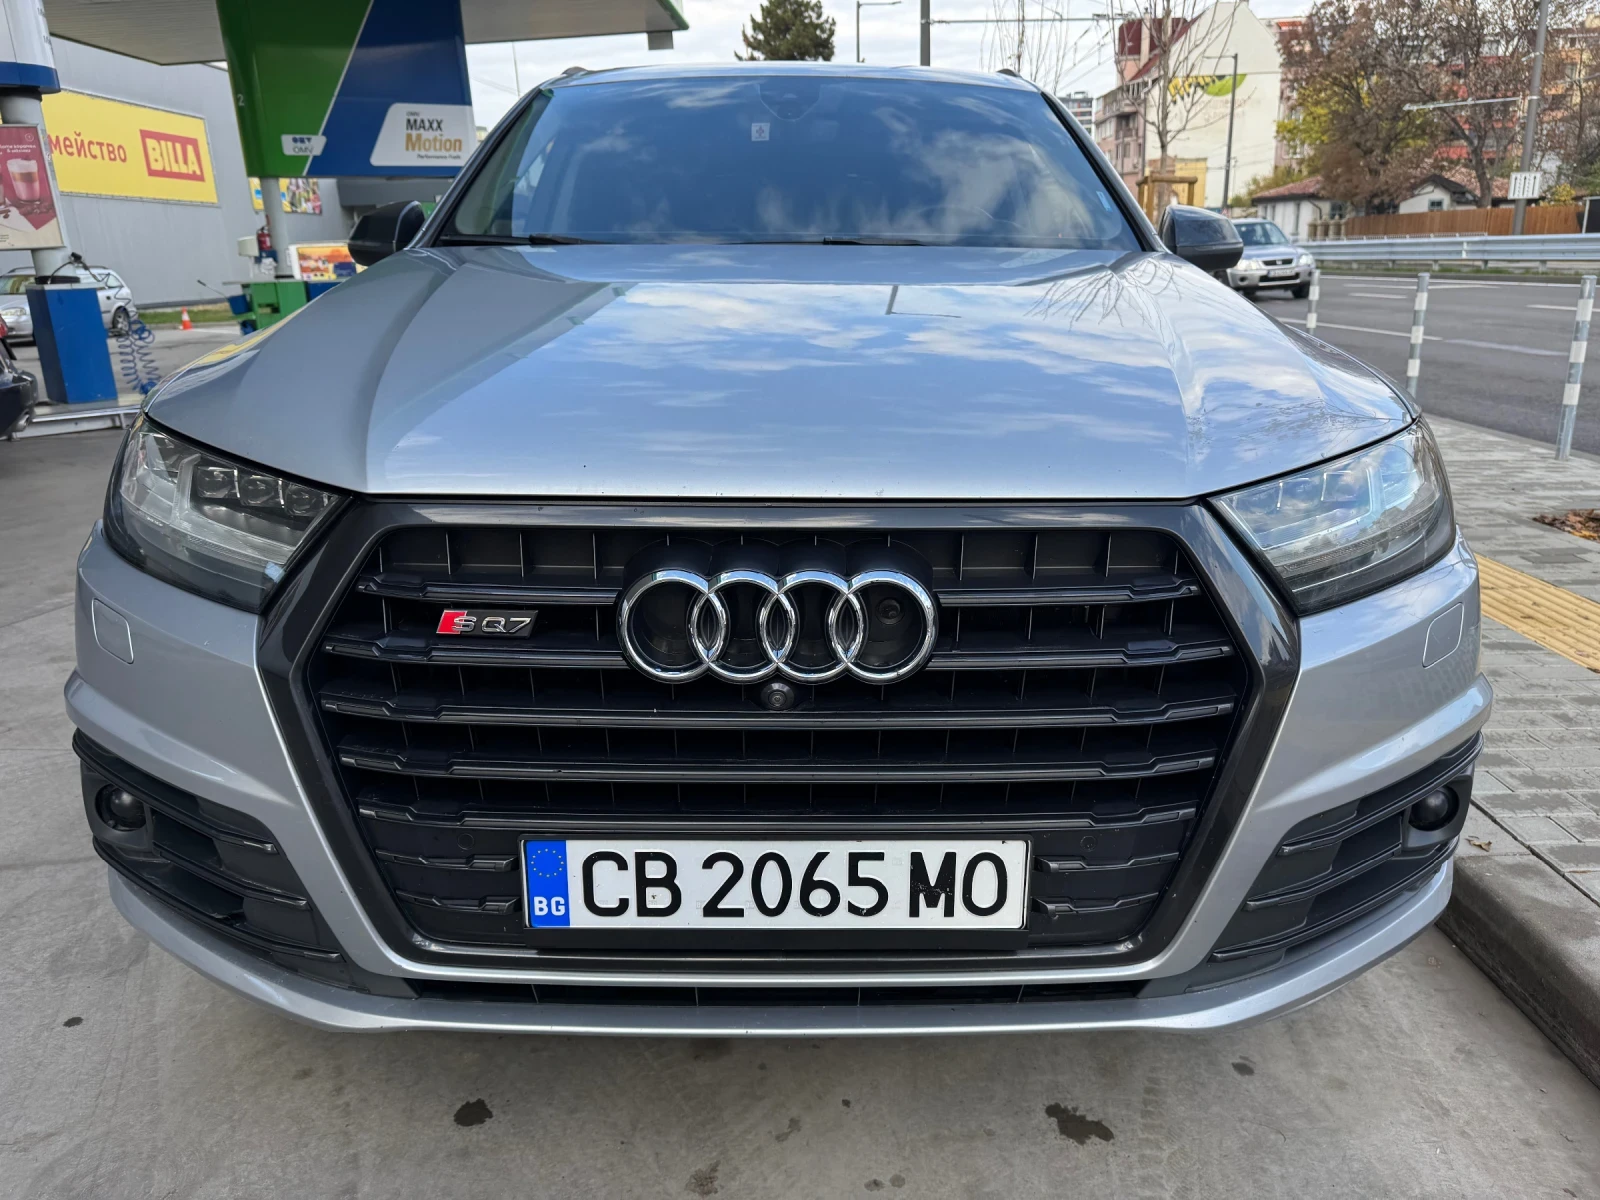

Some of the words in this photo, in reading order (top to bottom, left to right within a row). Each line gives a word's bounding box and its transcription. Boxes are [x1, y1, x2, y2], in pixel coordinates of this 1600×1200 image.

[237, 94, 245, 106] 2
[406, 118, 444, 132] MAXX
[292, 146, 314, 154] OMV
[405, 132, 462, 152] Motion
[145, 137, 201, 175] BILLA
[452, 616, 532, 633] SQ7
[582, 851, 682, 917] CB
[701, 851, 889, 917] 2065
[908, 851, 1008, 917] MO
[533, 896, 566, 916] BG
